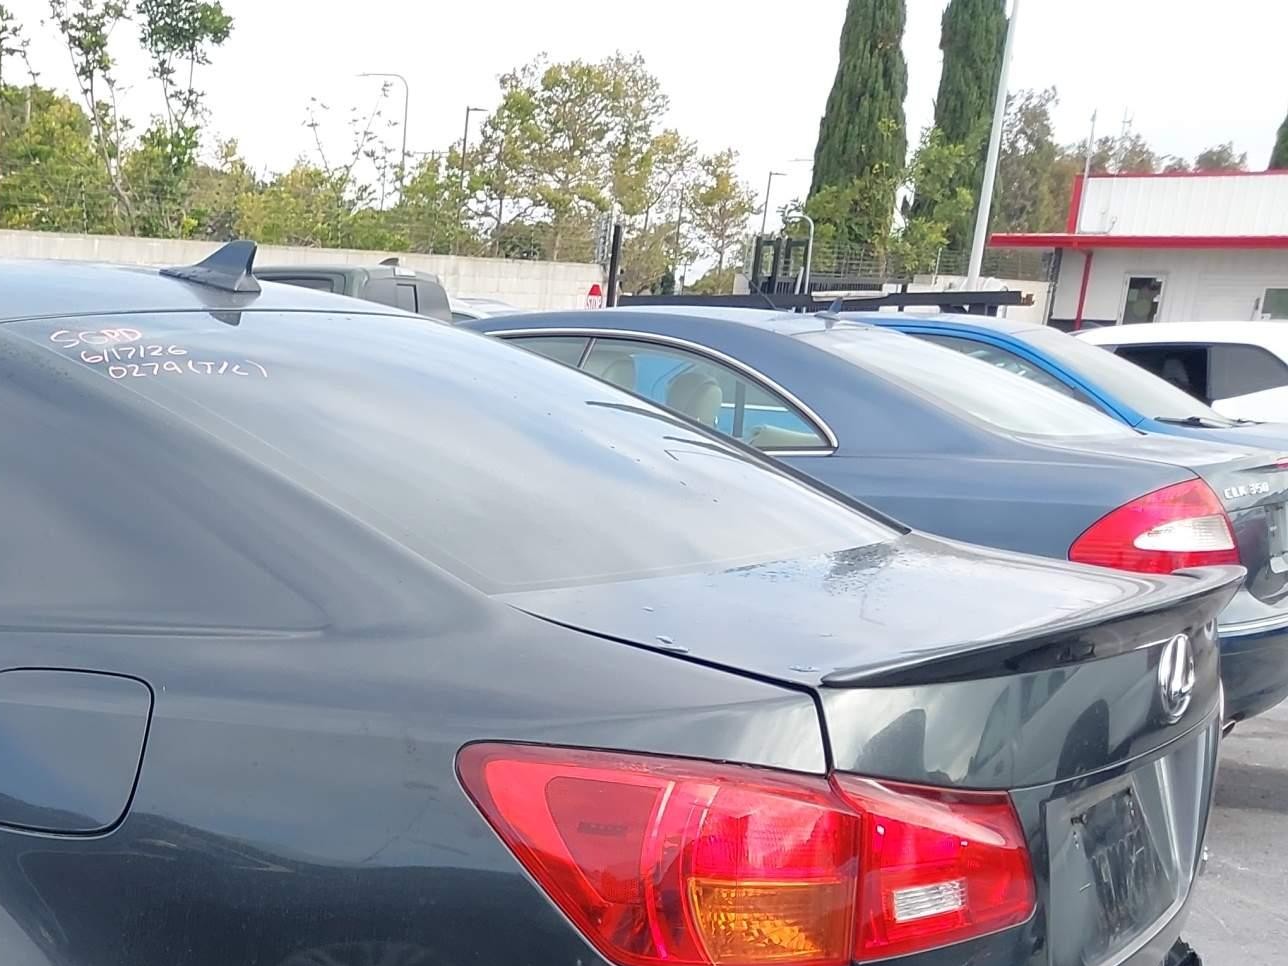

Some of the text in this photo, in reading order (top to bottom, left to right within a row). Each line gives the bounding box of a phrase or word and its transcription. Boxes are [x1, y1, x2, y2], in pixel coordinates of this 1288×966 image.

[50, 328, 143, 348] SGPD
[81, 344, 187, 363] 6/17/26
[1224, 481, 1269, 499] CLK 350
